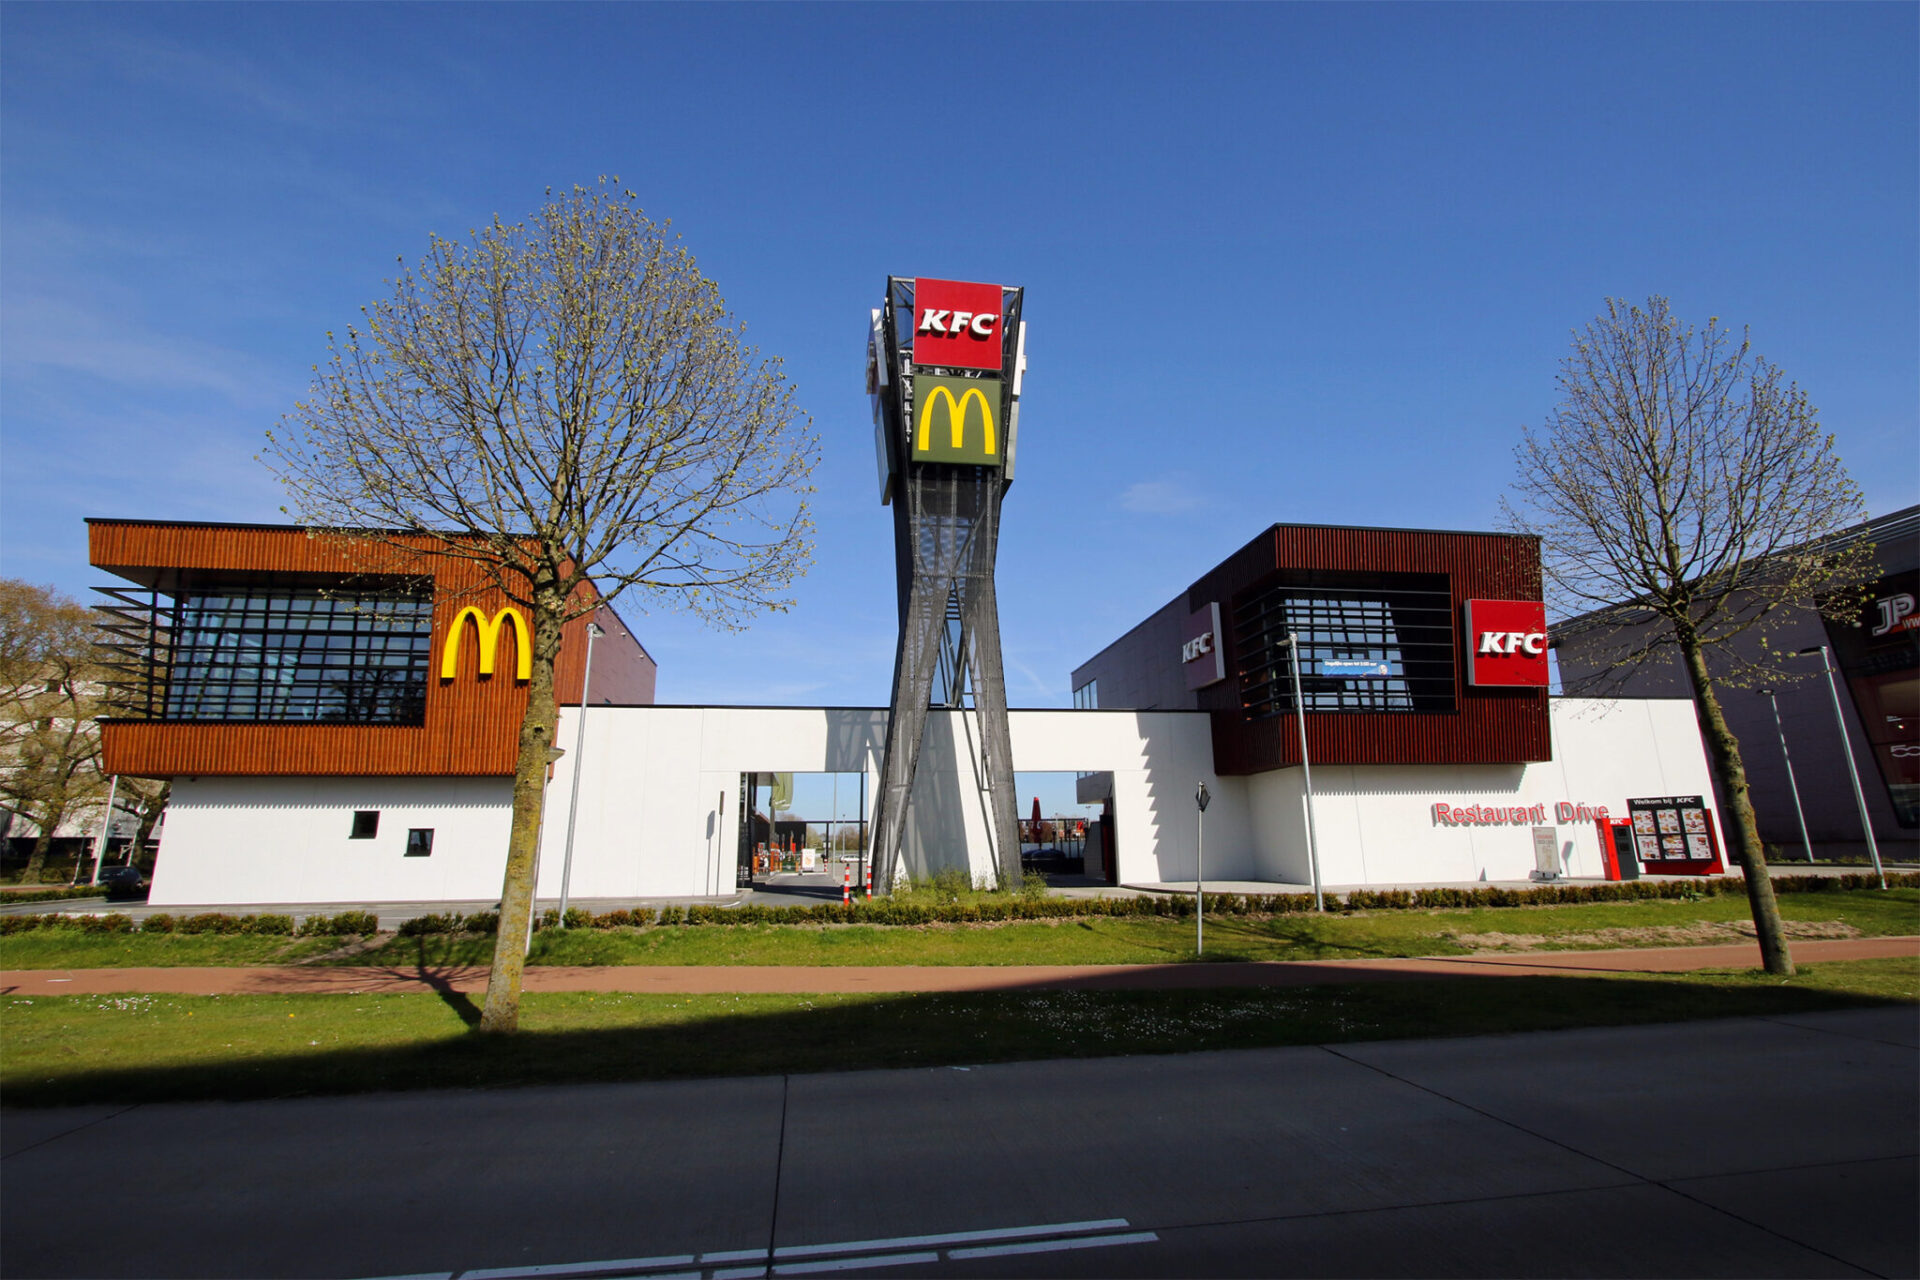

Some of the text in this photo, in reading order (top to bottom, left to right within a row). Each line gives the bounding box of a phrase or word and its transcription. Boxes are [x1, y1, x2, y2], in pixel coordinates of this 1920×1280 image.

[919, 308, 997, 336] KFC
[1872, 593, 1915, 636] JP
[1182, 632, 1212, 664] KFC
[1478, 631, 1544, 655] KFC
[1434, 801, 1609, 824] Restaurant Drive
[1633, 796, 1695, 806] Welkom bij KFC
